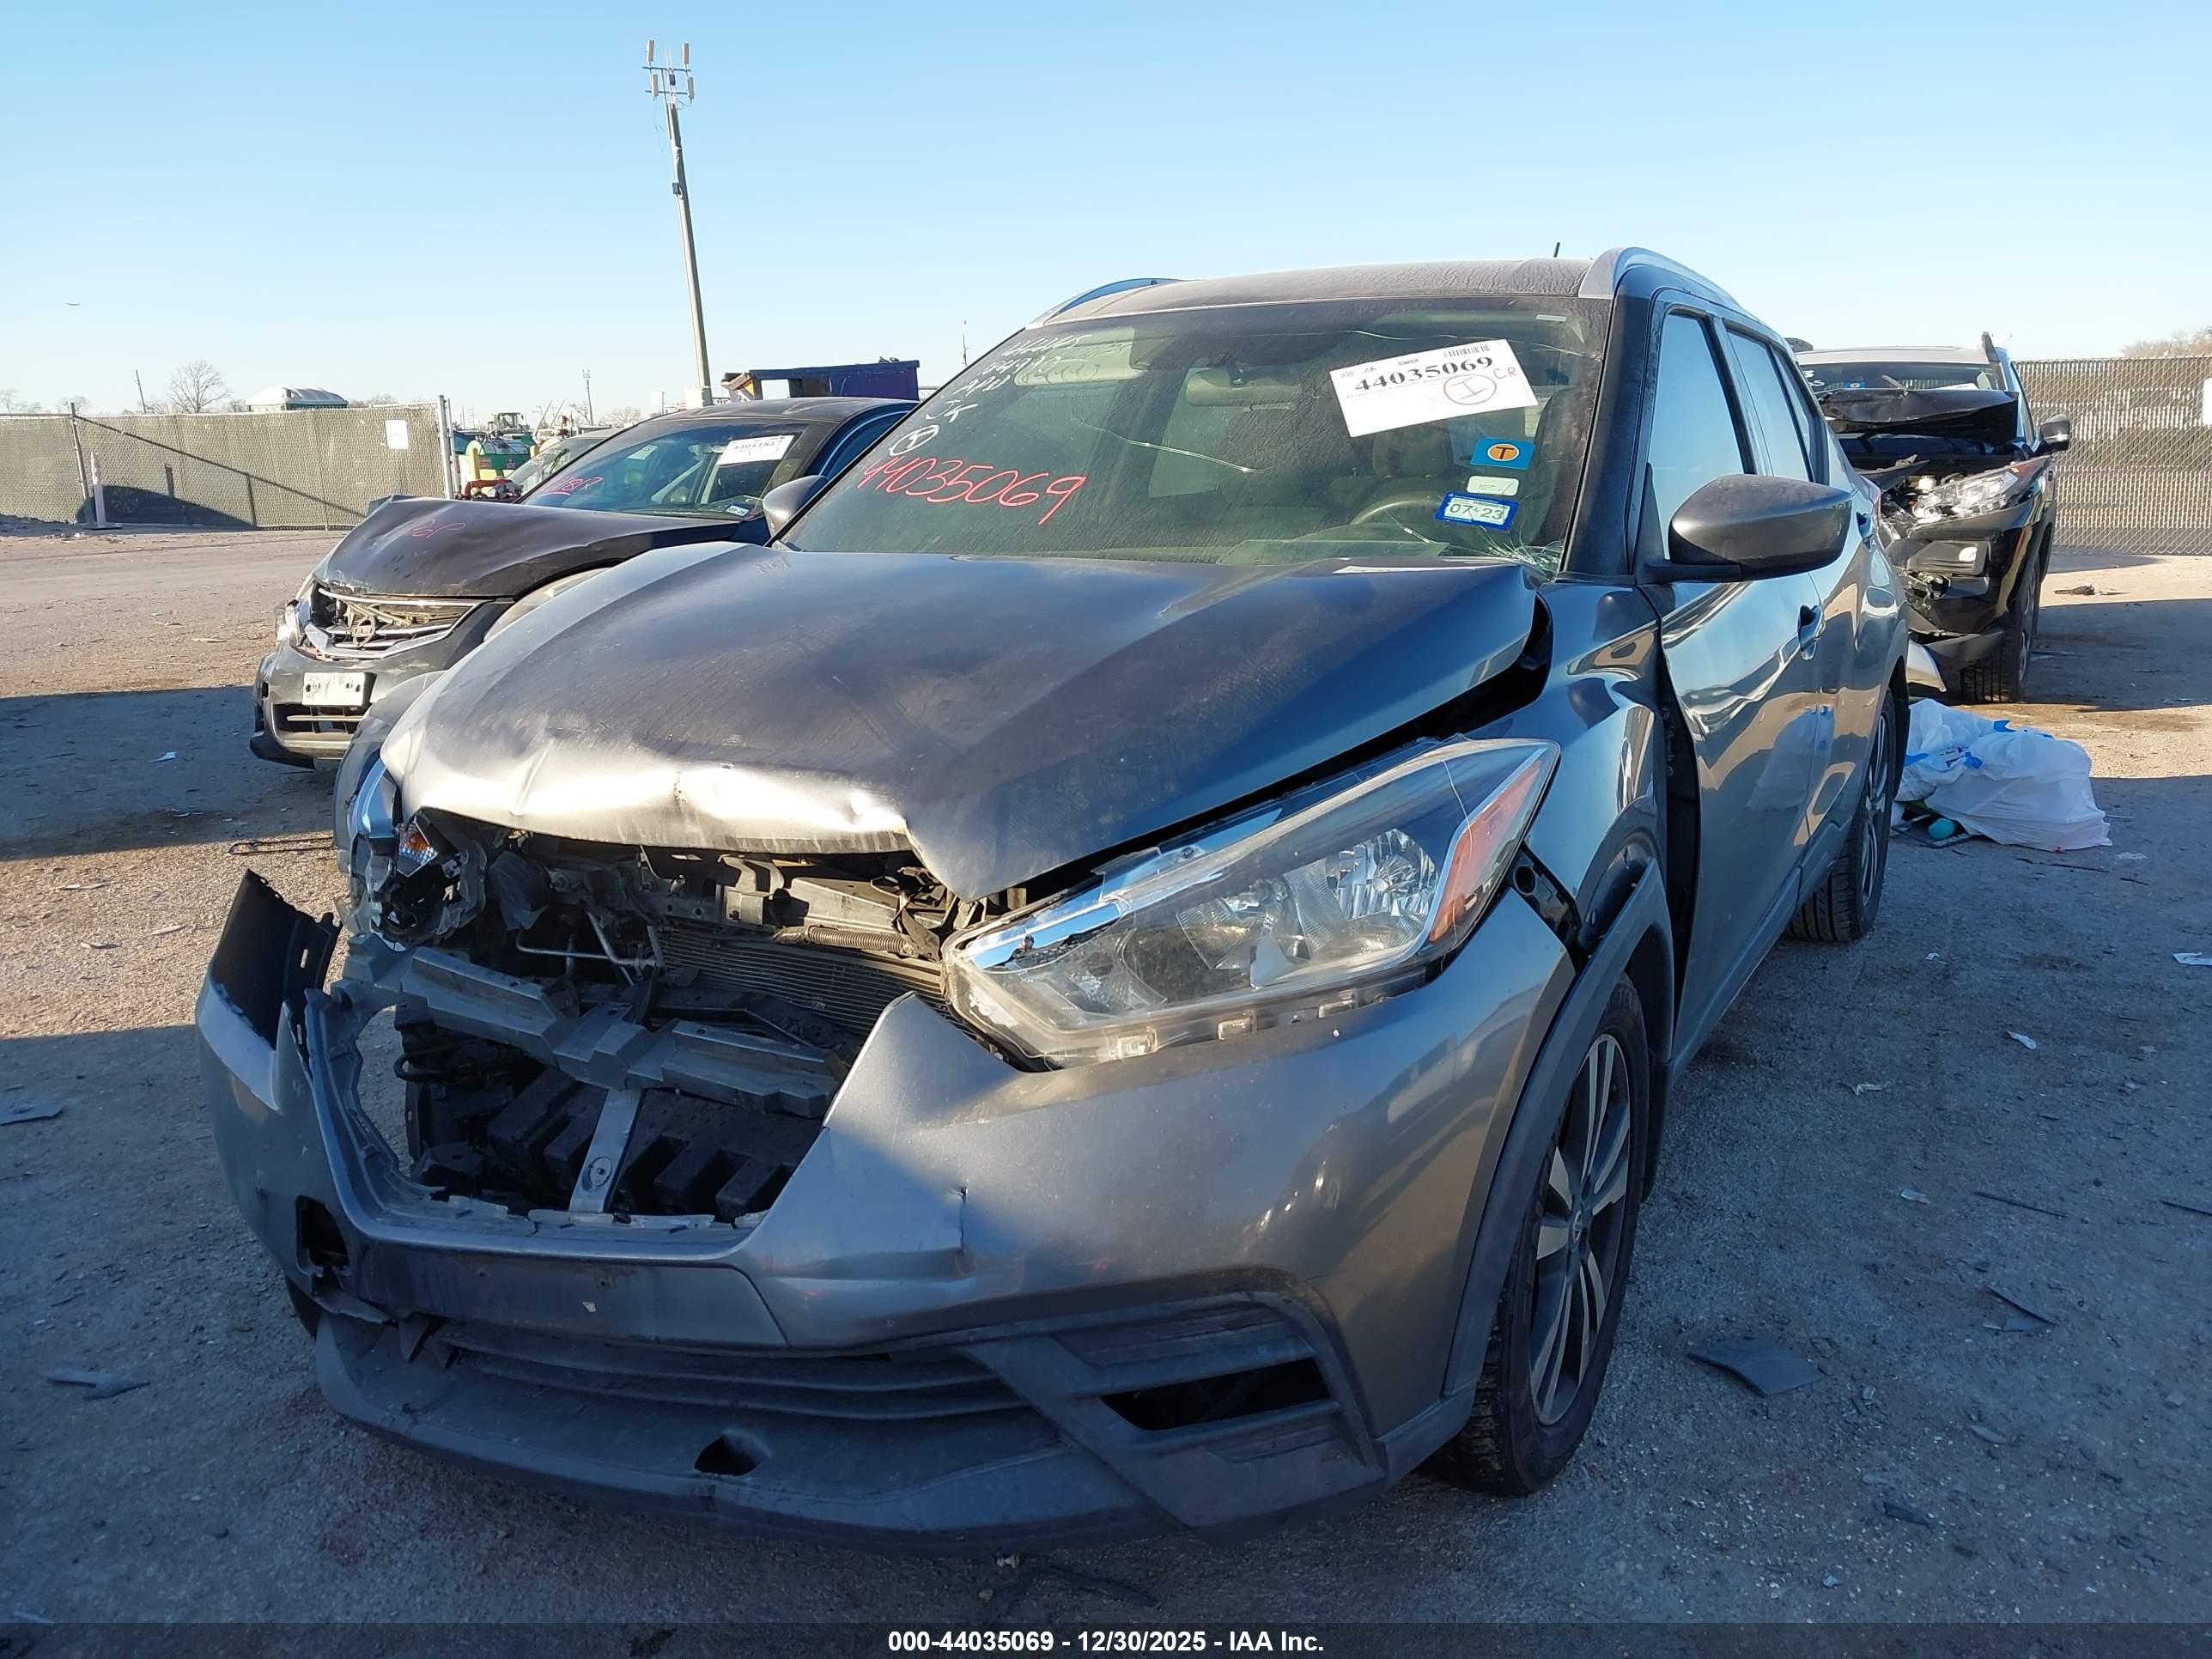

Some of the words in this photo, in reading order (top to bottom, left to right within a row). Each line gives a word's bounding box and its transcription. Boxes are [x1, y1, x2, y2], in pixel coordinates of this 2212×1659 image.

[1355, 356, 1493, 391] 44035069
[1496, 446, 1515, 459] T
[857, 456, 1088, 526] 44035069
